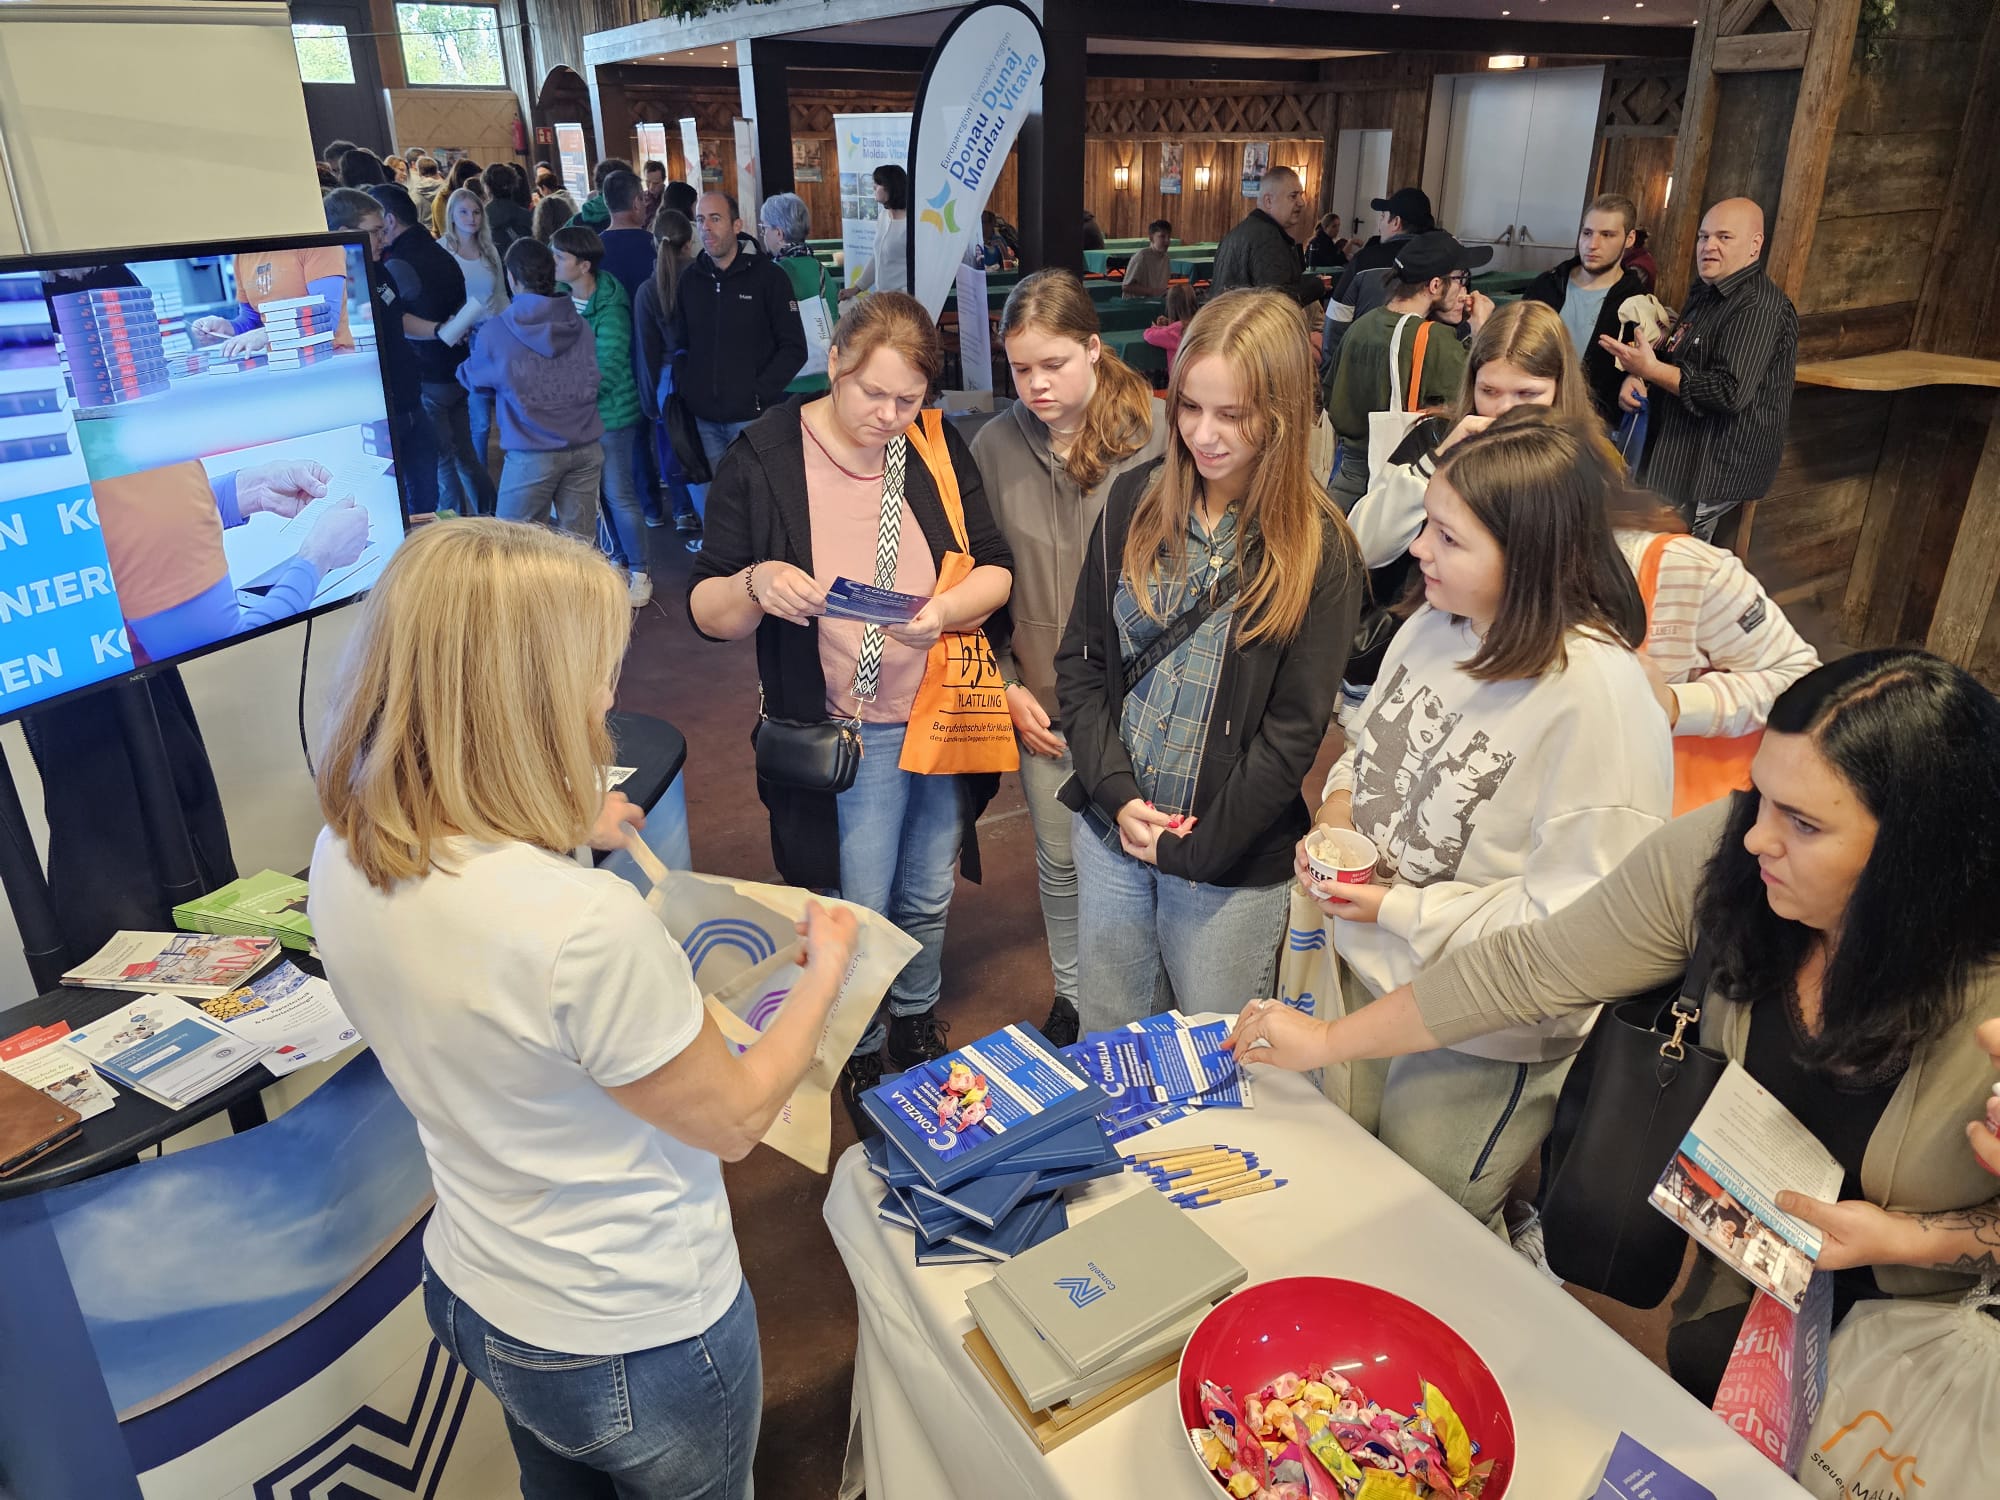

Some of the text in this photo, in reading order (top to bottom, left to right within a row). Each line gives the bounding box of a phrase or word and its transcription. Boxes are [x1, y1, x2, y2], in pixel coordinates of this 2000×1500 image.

[940, 107, 973, 170] Europaregion
[949, 47, 1023, 181] Donau Dunaj
[963, 53, 1040, 191] Moldau Vltava
[862, 137, 907, 149] Donau Dunaj
[863, 148, 907, 159] Moldau Vltav
[0, 563, 117, 624] NIER
[864, 587, 919, 602] CONZELLA
[0, 648, 63, 697] EN
[1124, 618, 1188, 686] SKECHE
[1096, 1041, 1115, 1081] CONZELLA
[891, 1090, 938, 1135] CONZELLA
[1747, 1198, 1807, 1249] Berufswahl
[1087, 1261, 1116, 1291] Conzella
[1731, 1326, 1793, 1382] efühl
